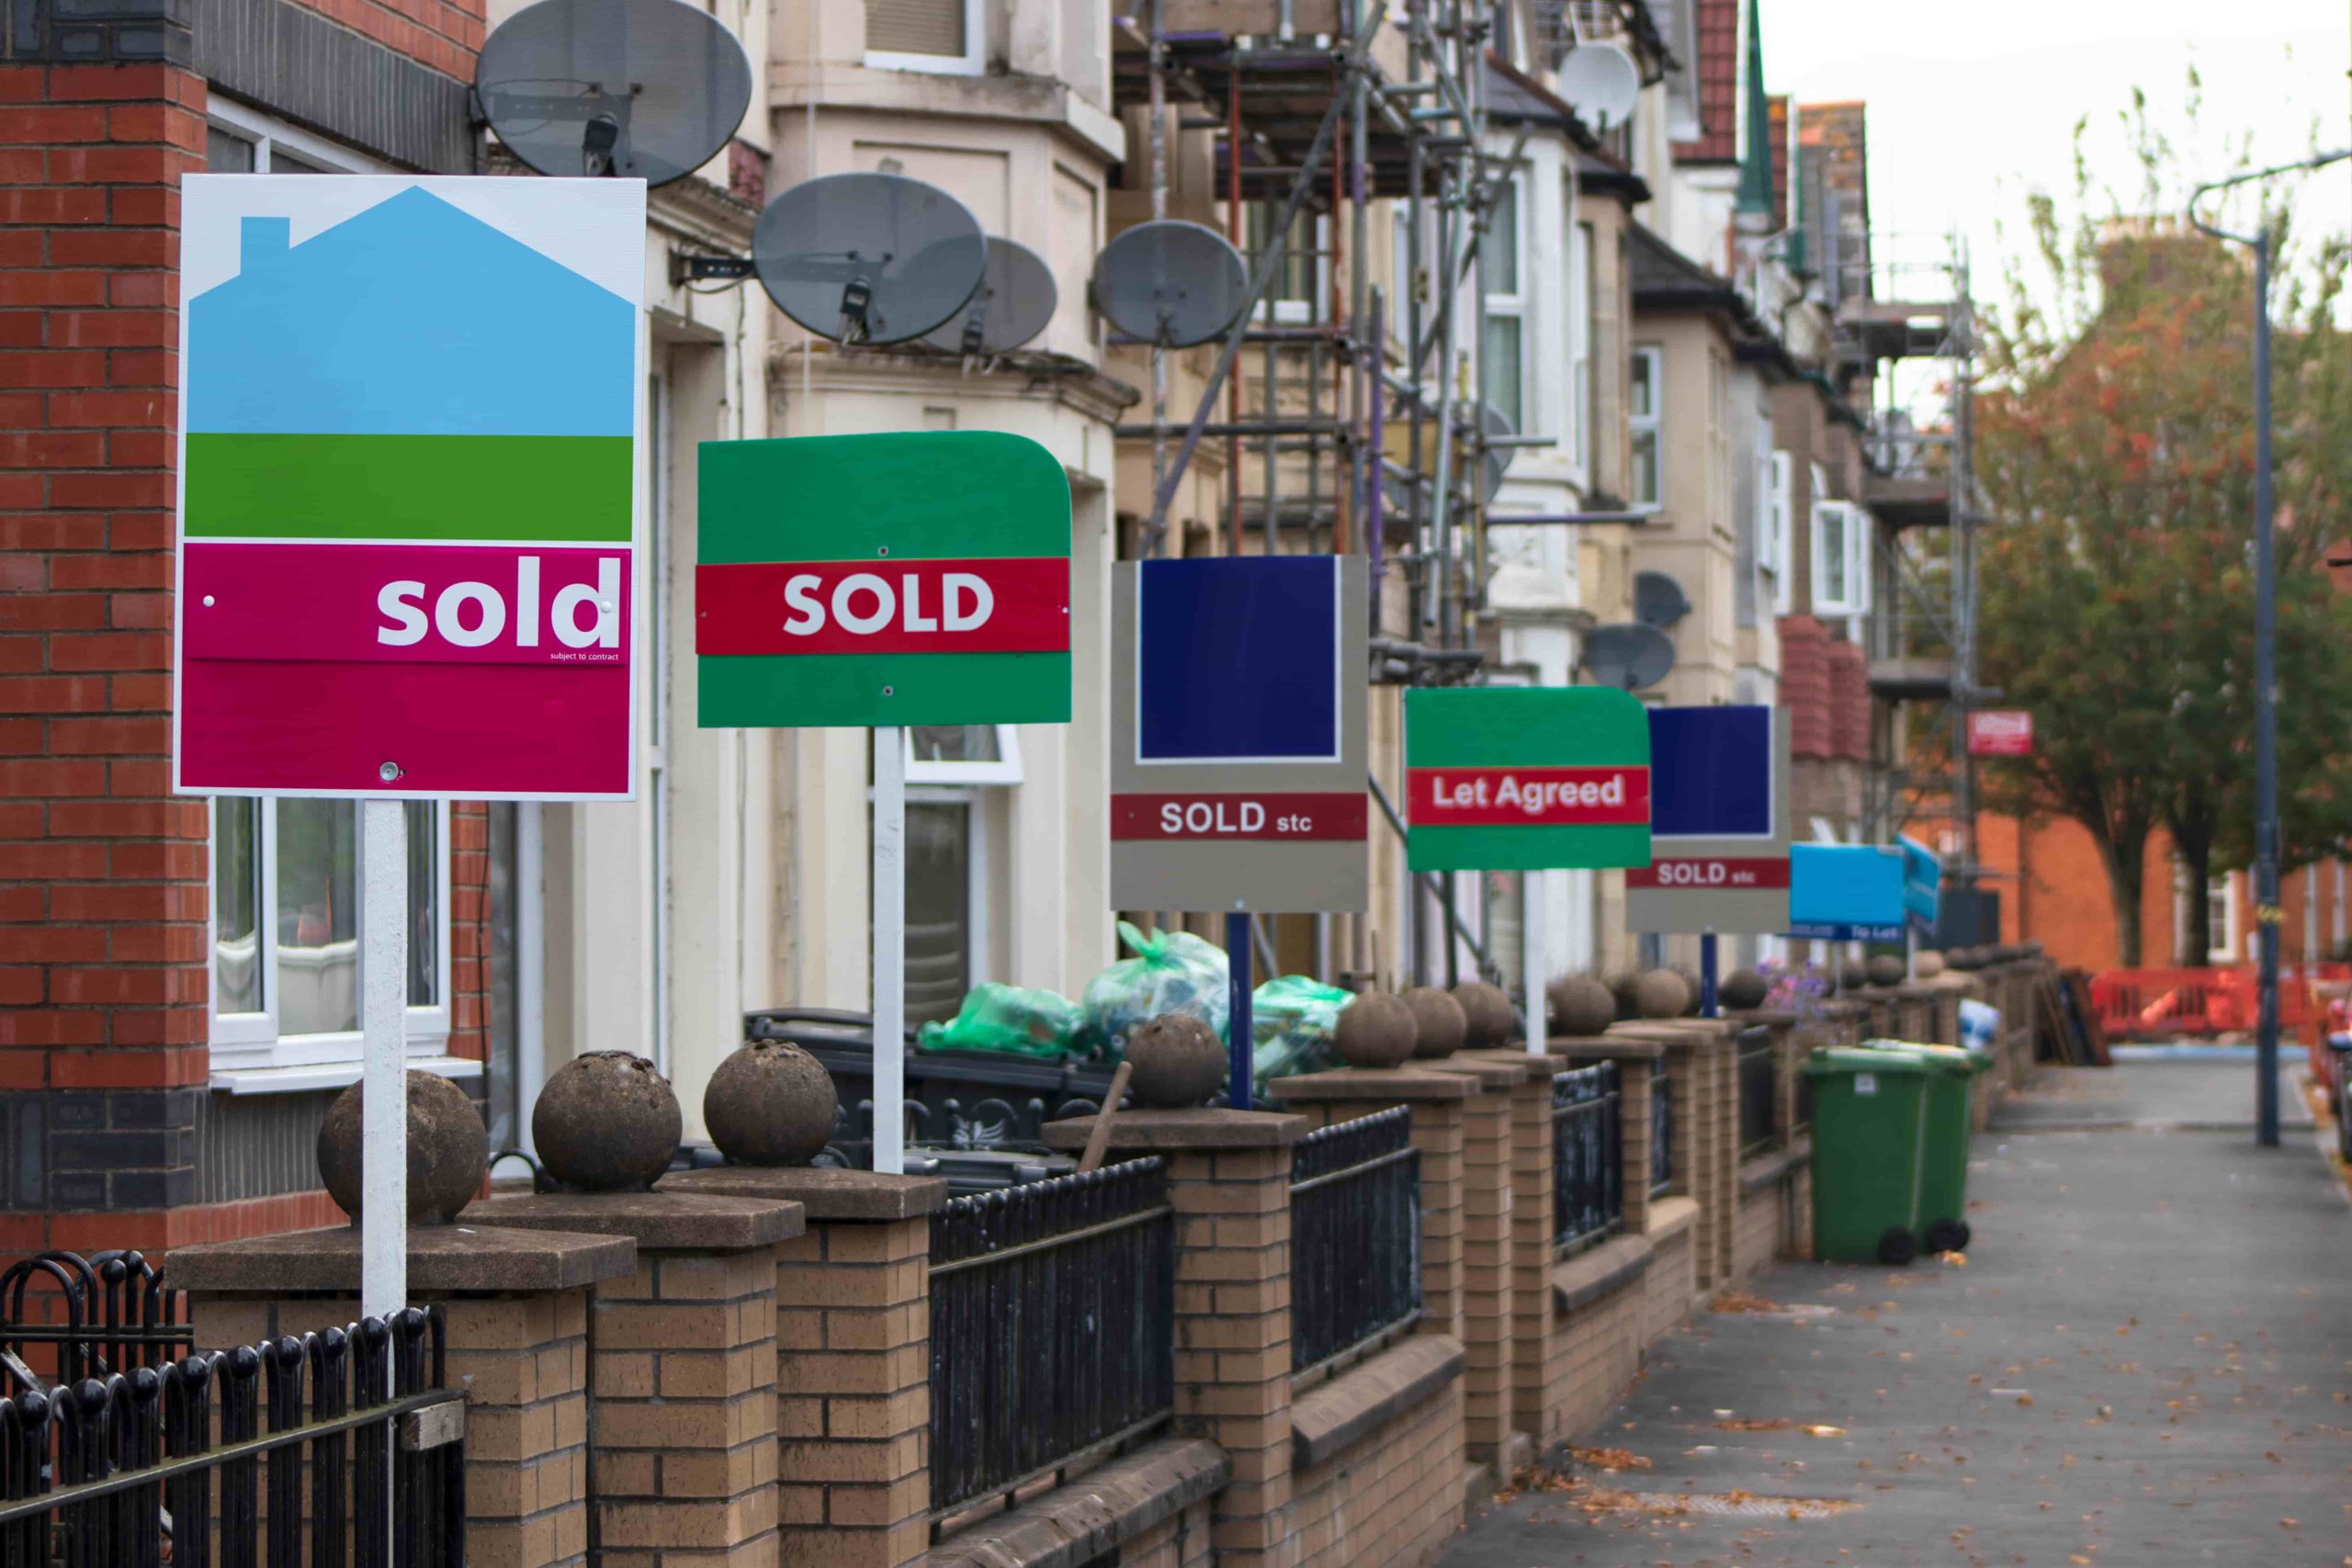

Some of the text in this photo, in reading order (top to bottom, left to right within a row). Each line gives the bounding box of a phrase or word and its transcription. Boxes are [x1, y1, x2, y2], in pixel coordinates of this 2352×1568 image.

[377, 555, 621, 649] sold
[783, 572, 994, 636] SOLD
[550, 652, 577, 660] subject
[1432, 773, 1623, 815] Let Agreed
[1160, 802, 1312, 833] SOLD stc
[1658, 863, 1756, 885] SOLD stc
[1851, 925, 1871, 938] To
